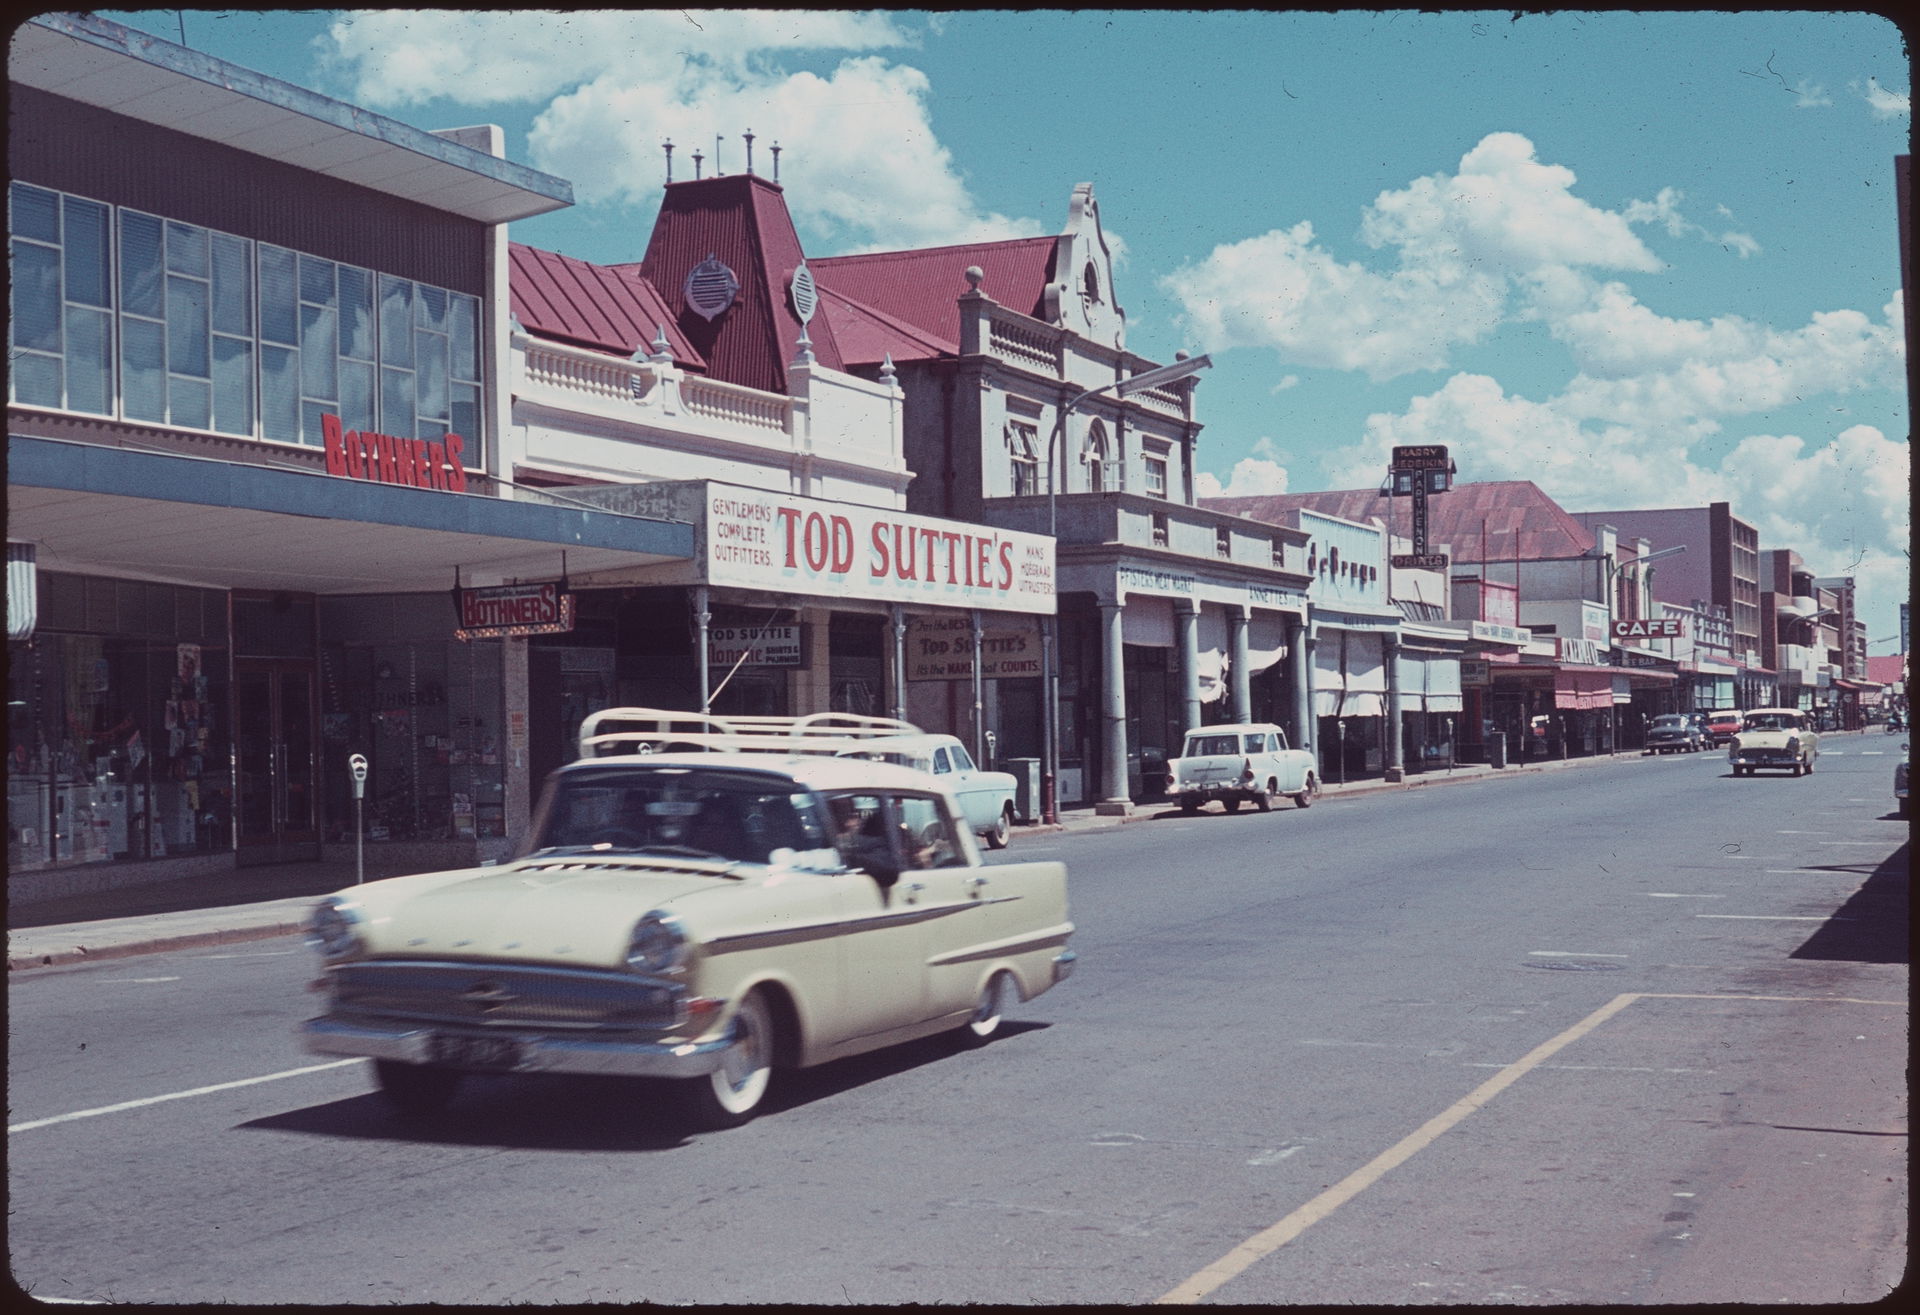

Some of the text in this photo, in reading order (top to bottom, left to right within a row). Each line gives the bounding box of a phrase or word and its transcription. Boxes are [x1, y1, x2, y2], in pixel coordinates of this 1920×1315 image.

[321, 413, 466, 494] BOTHNERS
[1414, 470, 1425, 555] PARTHENON
[717, 522, 766, 544] COMPLETE
[777, 506, 1014, 591] TOD SUTTIE'S
[463, 583, 556, 628] BOTHNERS
[740, 627, 792, 640] SUTTIE
[1616, 621, 1679, 636] CAFE
[947, 661, 972, 675] MAKE
[980, 660, 998, 673] hat
[1638, 657, 1657, 667] BAR
